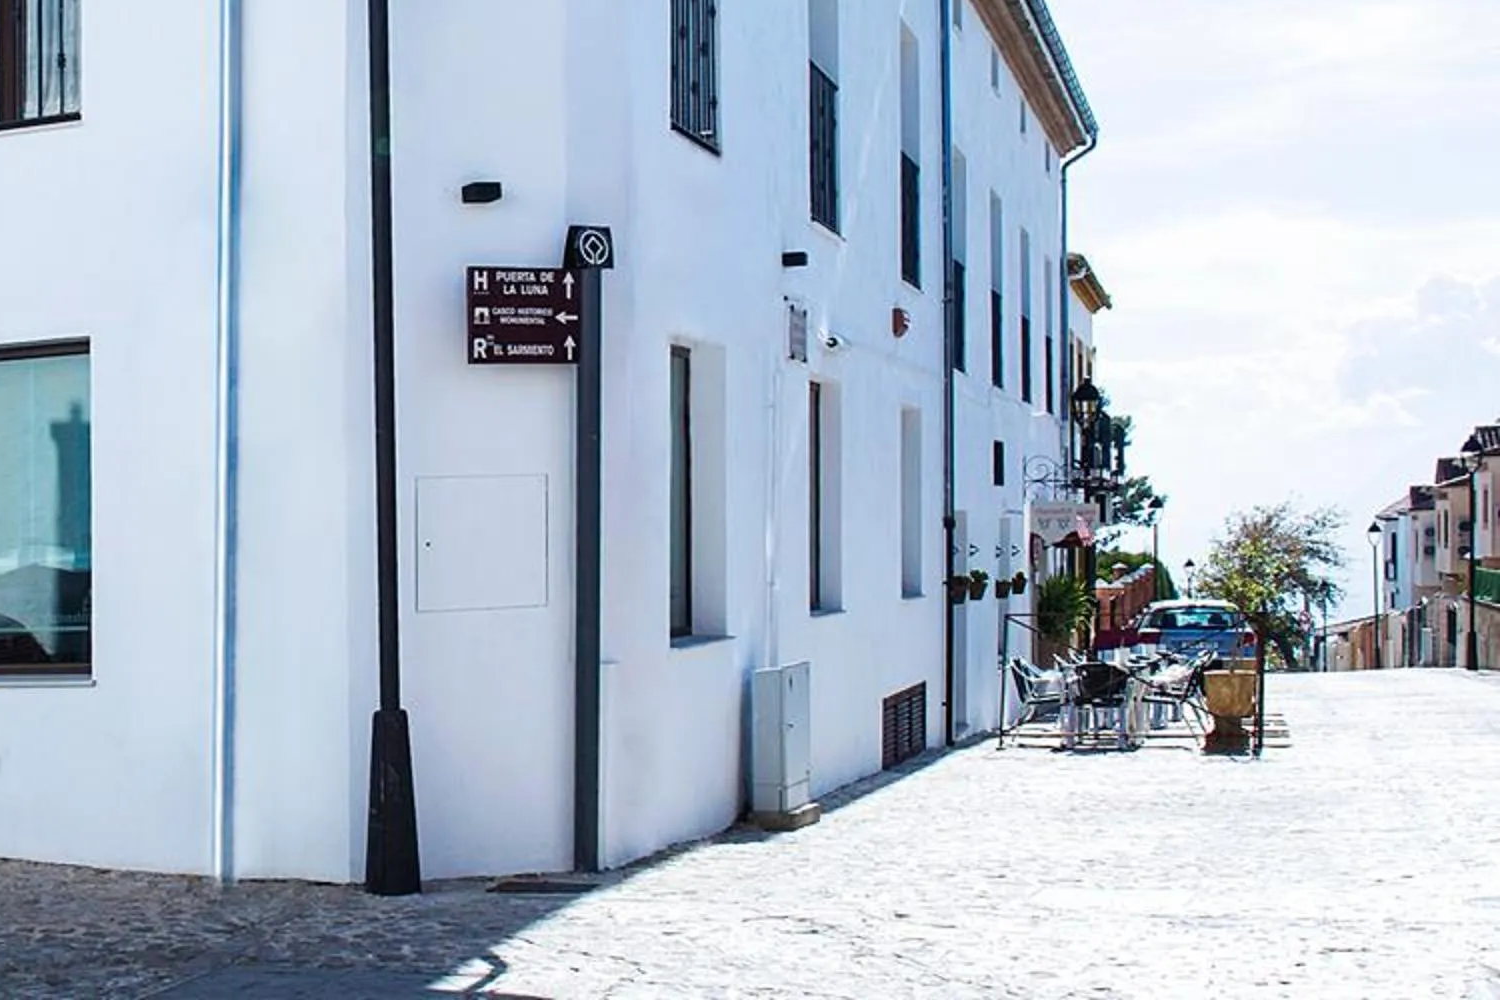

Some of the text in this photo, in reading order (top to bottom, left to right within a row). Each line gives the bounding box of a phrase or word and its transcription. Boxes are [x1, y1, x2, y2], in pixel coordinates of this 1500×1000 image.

[473, 270, 489, 291] H
[495, 271, 555, 283] PUERTA DE
[503, 284, 549, 296] LA LUNA
[473, 337, 487, 359] R
[493, 344, 504, 355] EL
